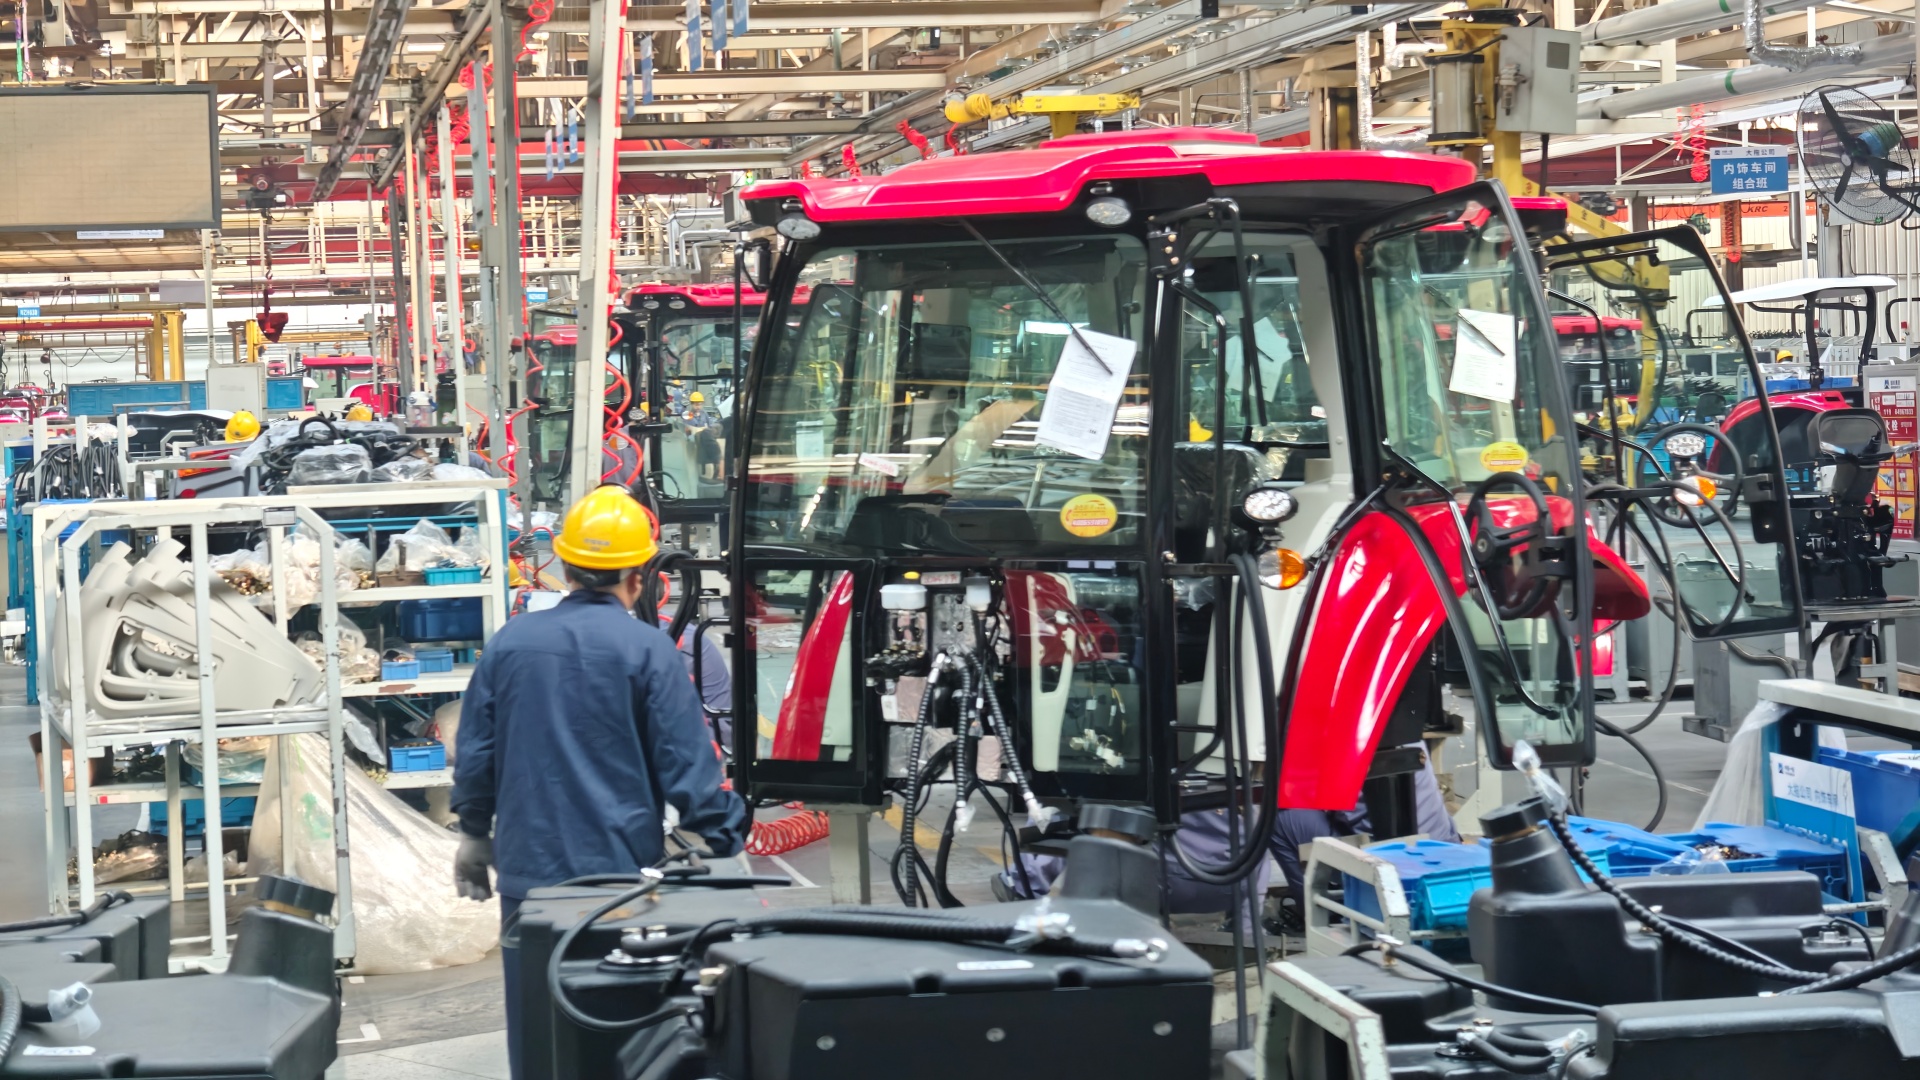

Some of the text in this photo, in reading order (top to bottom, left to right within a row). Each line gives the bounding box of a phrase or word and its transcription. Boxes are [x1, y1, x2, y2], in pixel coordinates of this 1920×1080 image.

[1723, 161, 1776, 175] 内饰车间
[1732, 177, 1768, 190] 组合班
[1748, 205, 1769, 213] KRC
